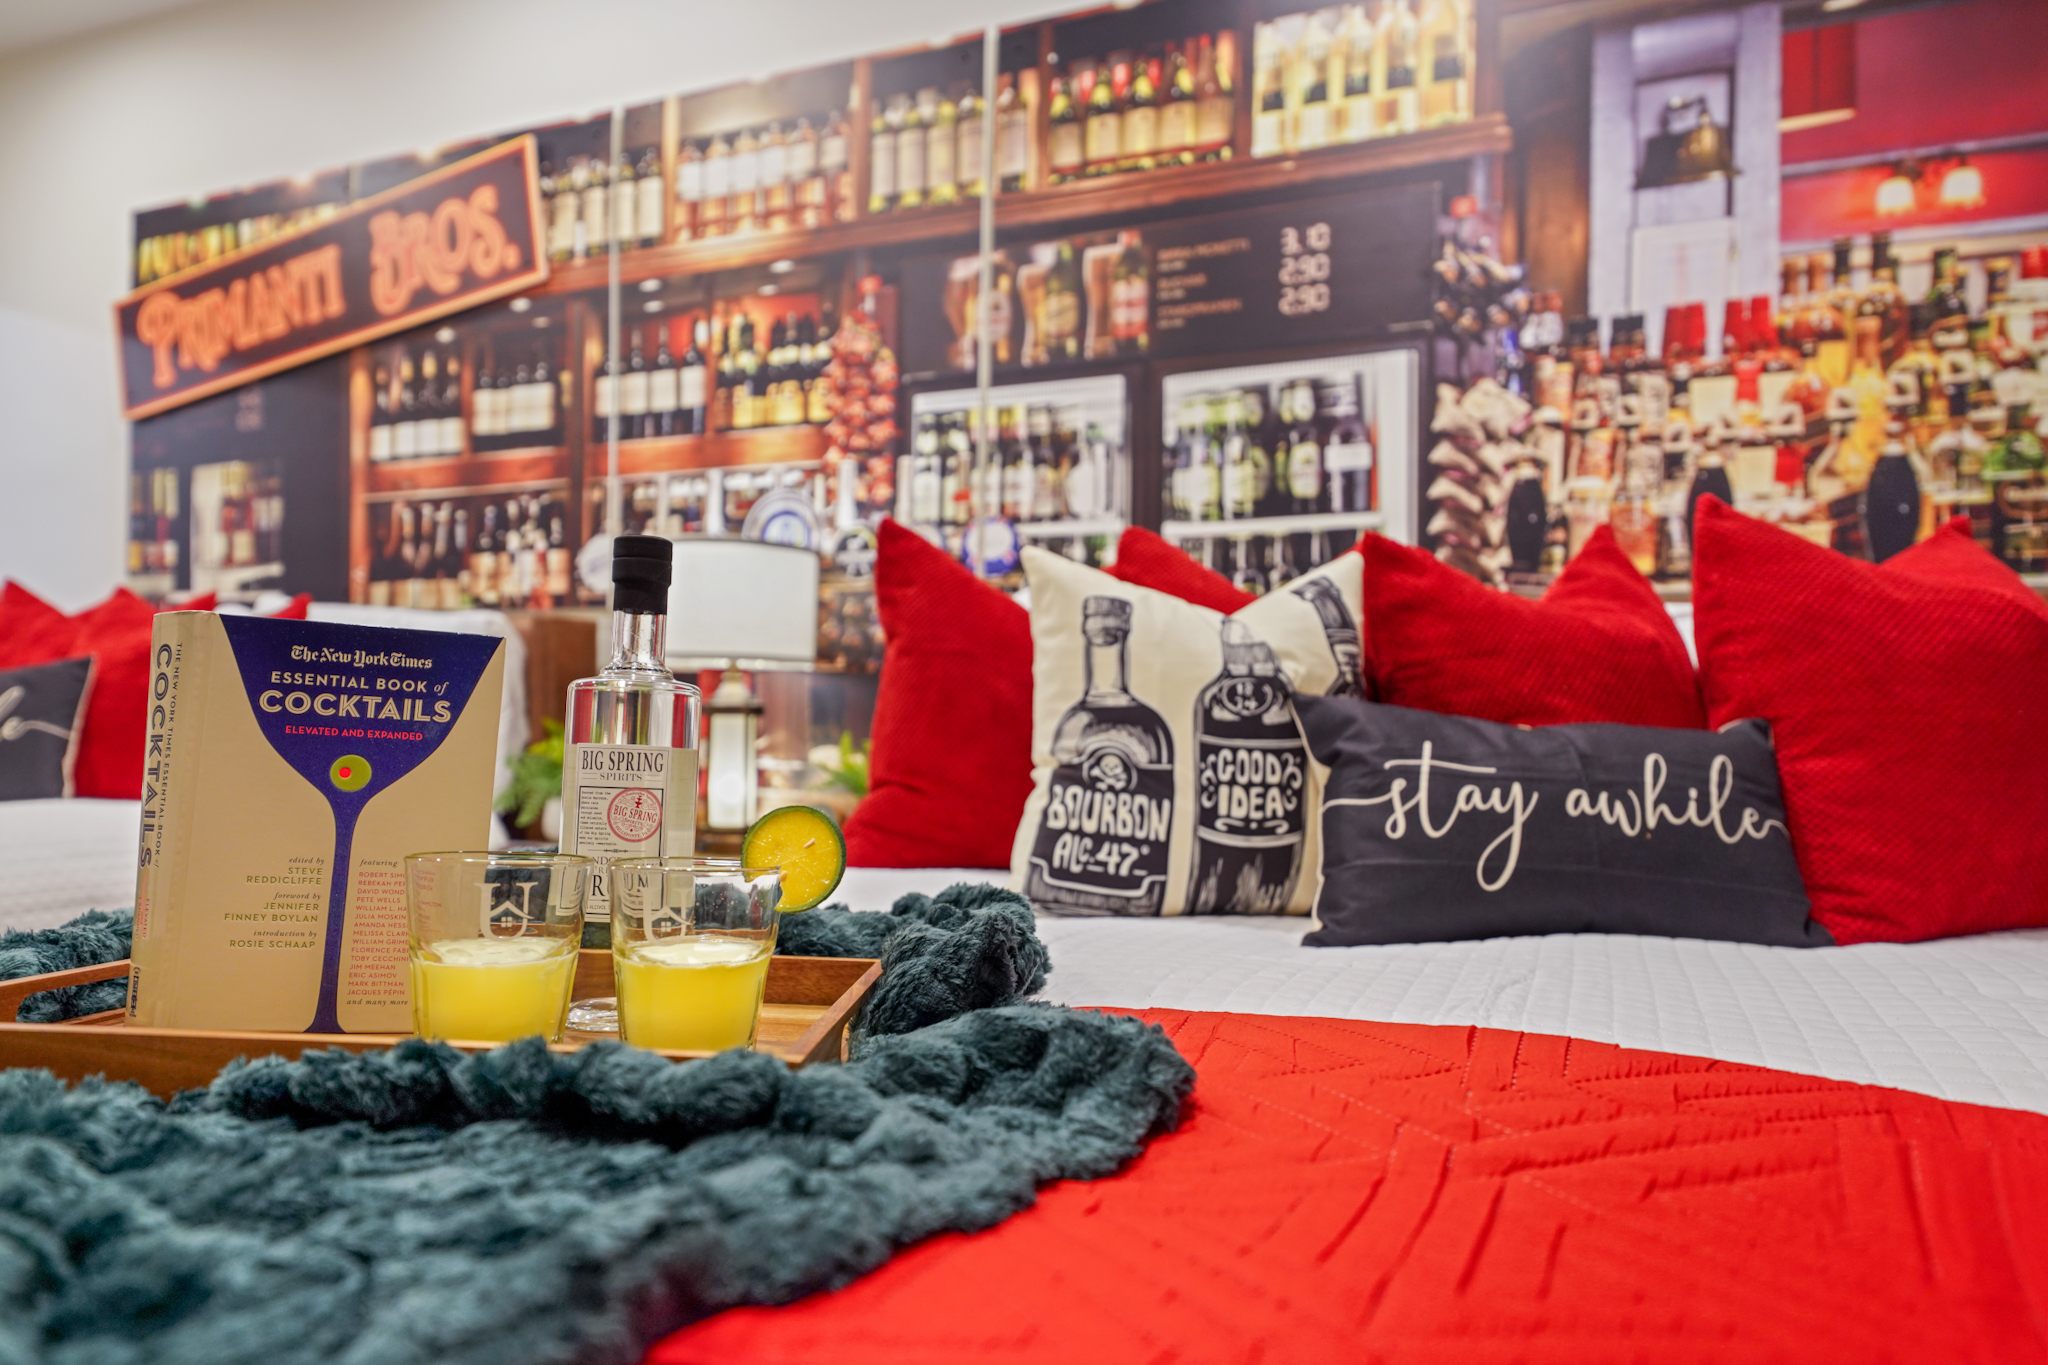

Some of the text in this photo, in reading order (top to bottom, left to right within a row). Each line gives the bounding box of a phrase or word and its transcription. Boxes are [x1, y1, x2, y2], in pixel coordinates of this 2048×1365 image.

[136, 184, 521, 389] PRIMANTI BROS.
[174, 642, 183, 663] THE
[291, 645, 433, 669] The New York Times
[172, 667, 180, 691] NEW
[271, 670, 450, 696] ESSENTIAL BOOK of
[168, 694, 177, 723] YORK
[259, 689, 452, 723] COCKTAILS
[285, 725, 423, 741] ELEVATED AND EXPANDED
[165, 727, 174, 759] TIMES
[140, 643, 173, 868] COCKTAILS
[582, 750, 664, 772] BIG SPRING
[1217, 748, 1282, 785] GOOD
[600, 772, 642, 781] SPIRITS
[1217, 784, 1284, 820] IDEA
[613, 804, 658, 824] BIG SPRING
[1046, 784, 1171, 843] BOURBON
[1384, 740, 1790, 891] stay awhile
[288, 856, 325, 867] edited by
[359, 858, 398, 868] featuring
[287, 867, 323, 876] STEVE
[358, 871, 388, 879] ROBERT
[246, 875, 322, 885] REDDICLIFFE
[358, 879, 391, 887] REBEKAH
[274, 891, 321, 902] foreword by
[357, 888, 405, 896] DAVID WOND
[356, 896, 375, 904] PETE
[263, 902, 319, 911] JENNIFER
[224, 913, 318, 923] FINNEY BOYLAN
[354, 913, 407, 921] JULIA MOSKIN
[353, 921, 386, 929] AMANDA
[253, 929, 318, 940] introduction by
[229, 939, 316, 949] ROSIE SCHAAP
[352, 938, 409, 946] WILLIAM GRIME
[351, 946, 391, 954] FLORENCE
[350, 954, 409, 963] TOBY CECCHINI
[350, 963, 396, 971] JIM MEEHAN
[349, 971, 398, 980] ERIC ASIMOV
[371, 980, 404, 988] BITTMAN
[347, 987, 405, 996] JACQUES PÉPIN
[346, 998, 362, 1006] and
[365, 999, 387, 1008] many
